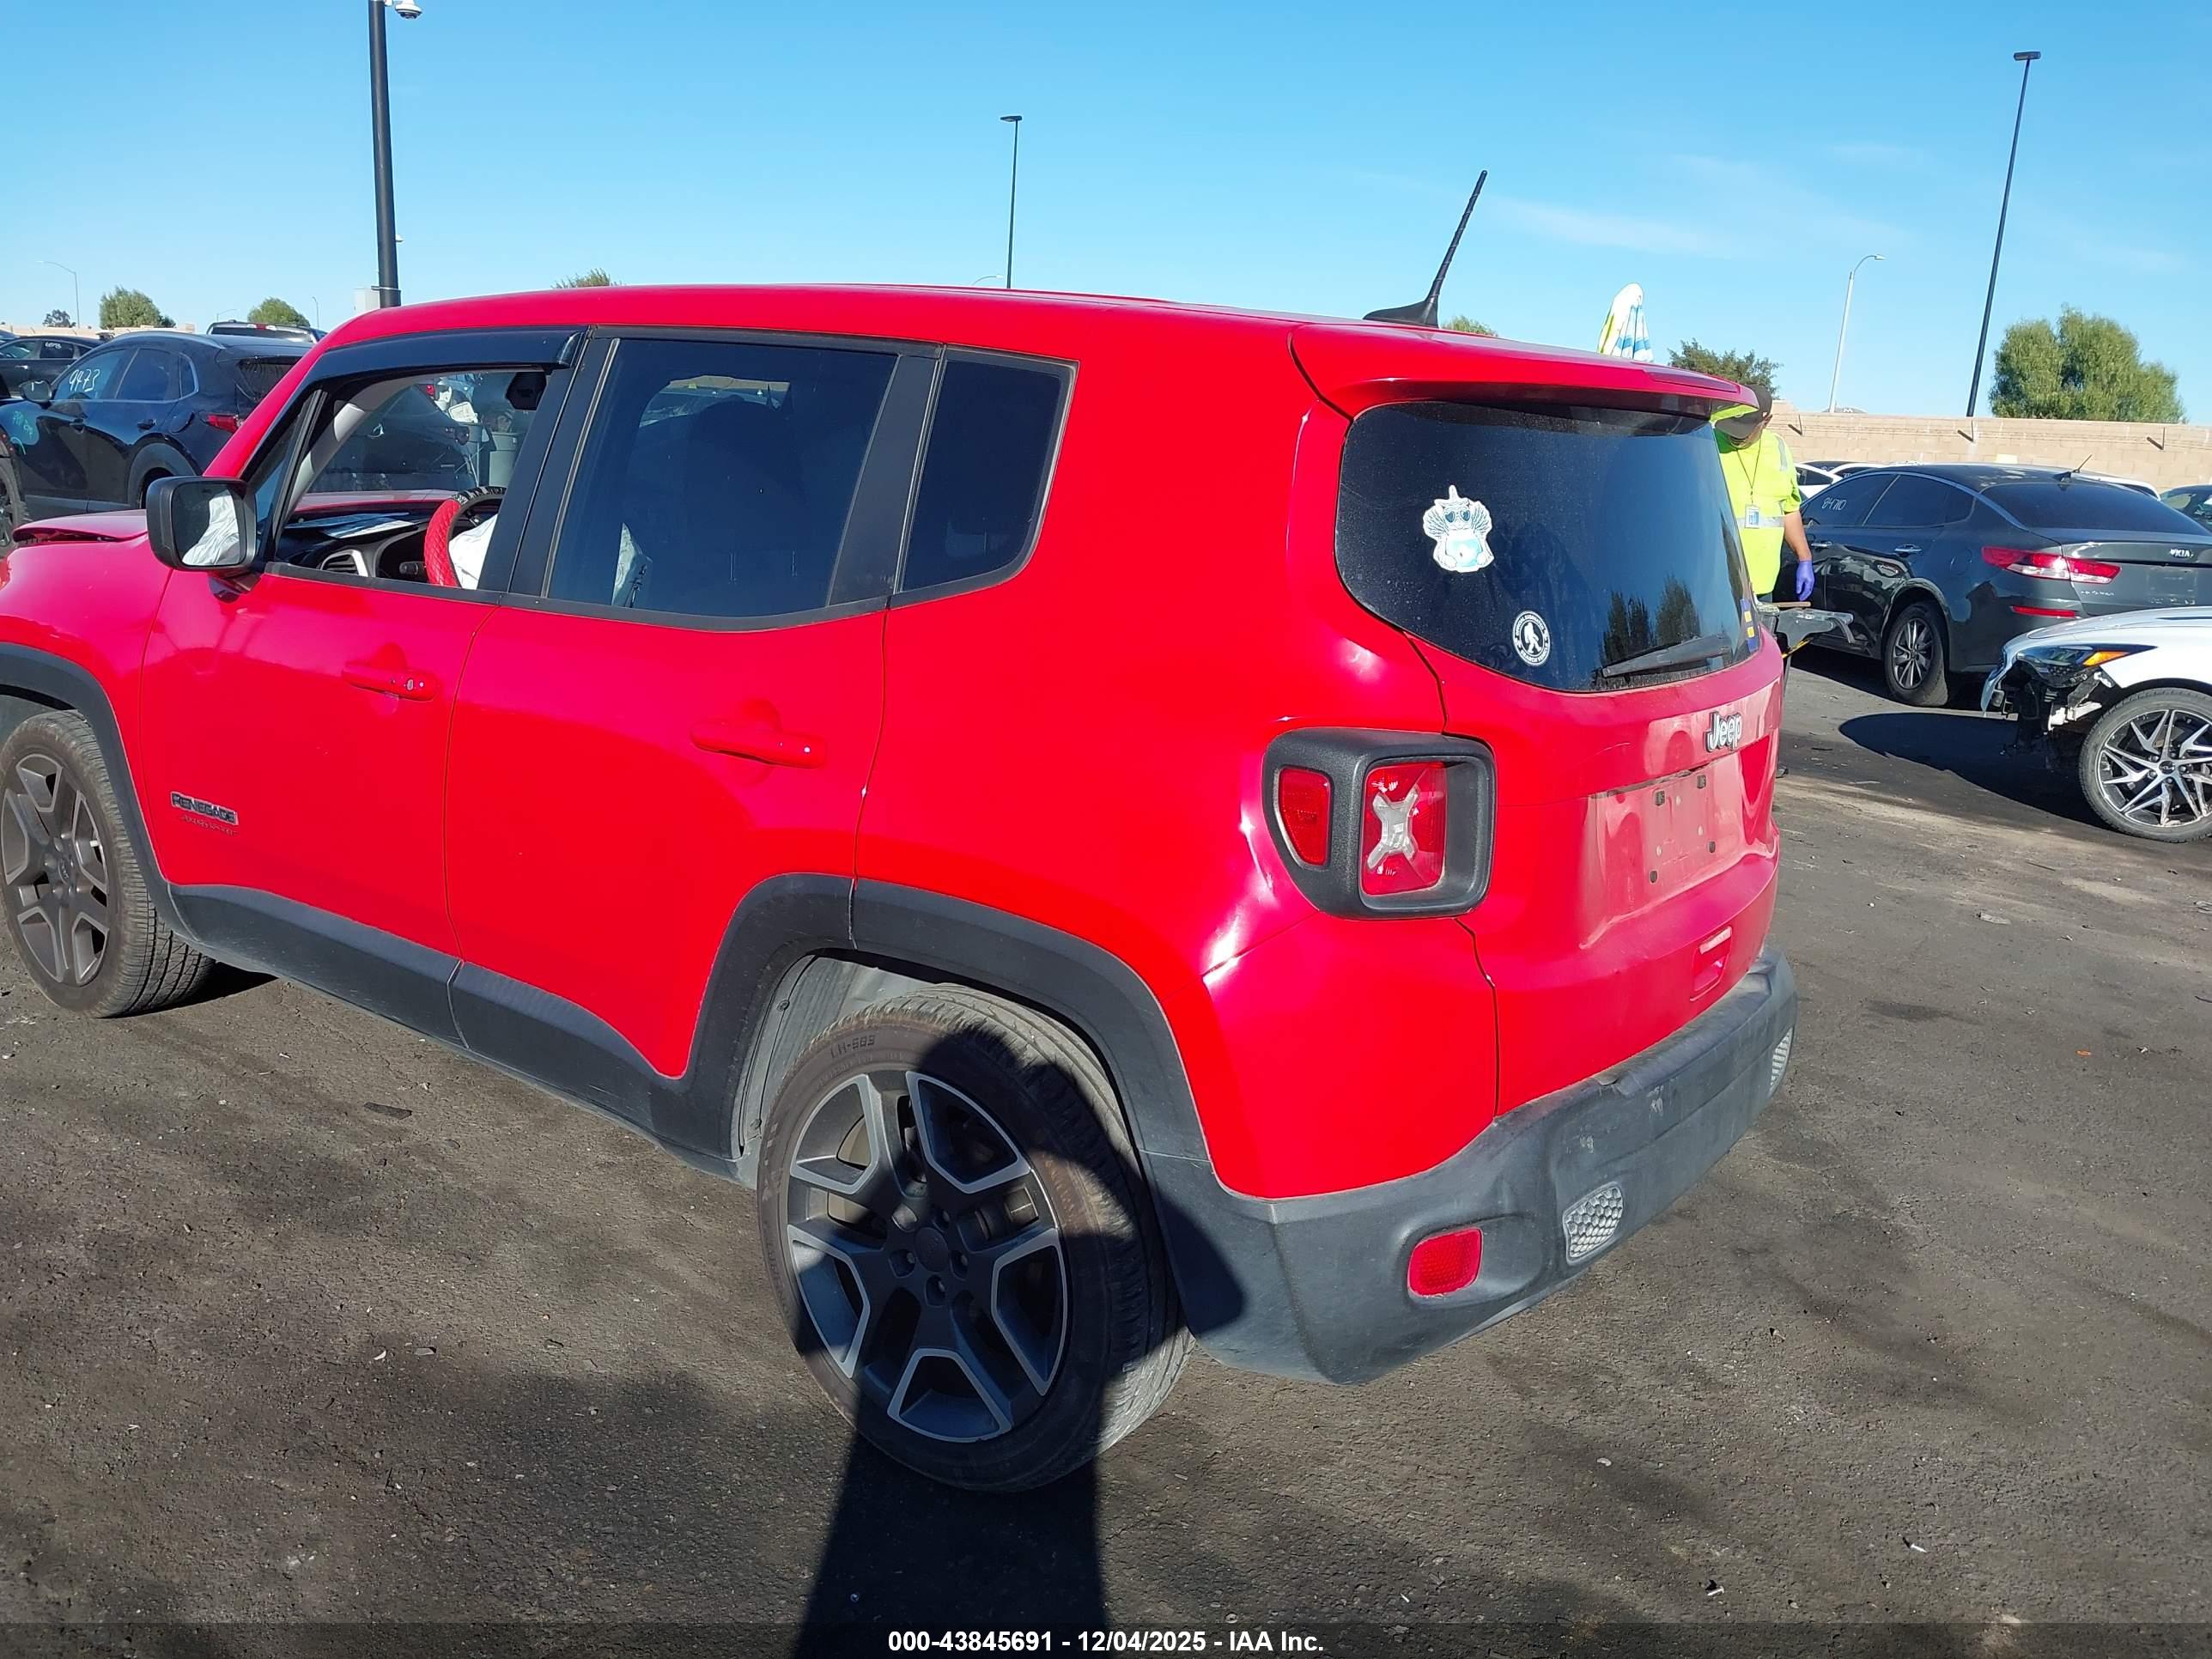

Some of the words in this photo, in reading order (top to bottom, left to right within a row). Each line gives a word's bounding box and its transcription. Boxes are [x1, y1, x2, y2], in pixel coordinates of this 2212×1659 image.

[69, 368, 100, 392] 9473
[1704, 711, 1742, 753] Jeep
[170, 791, 240, 825] RENEGADE
